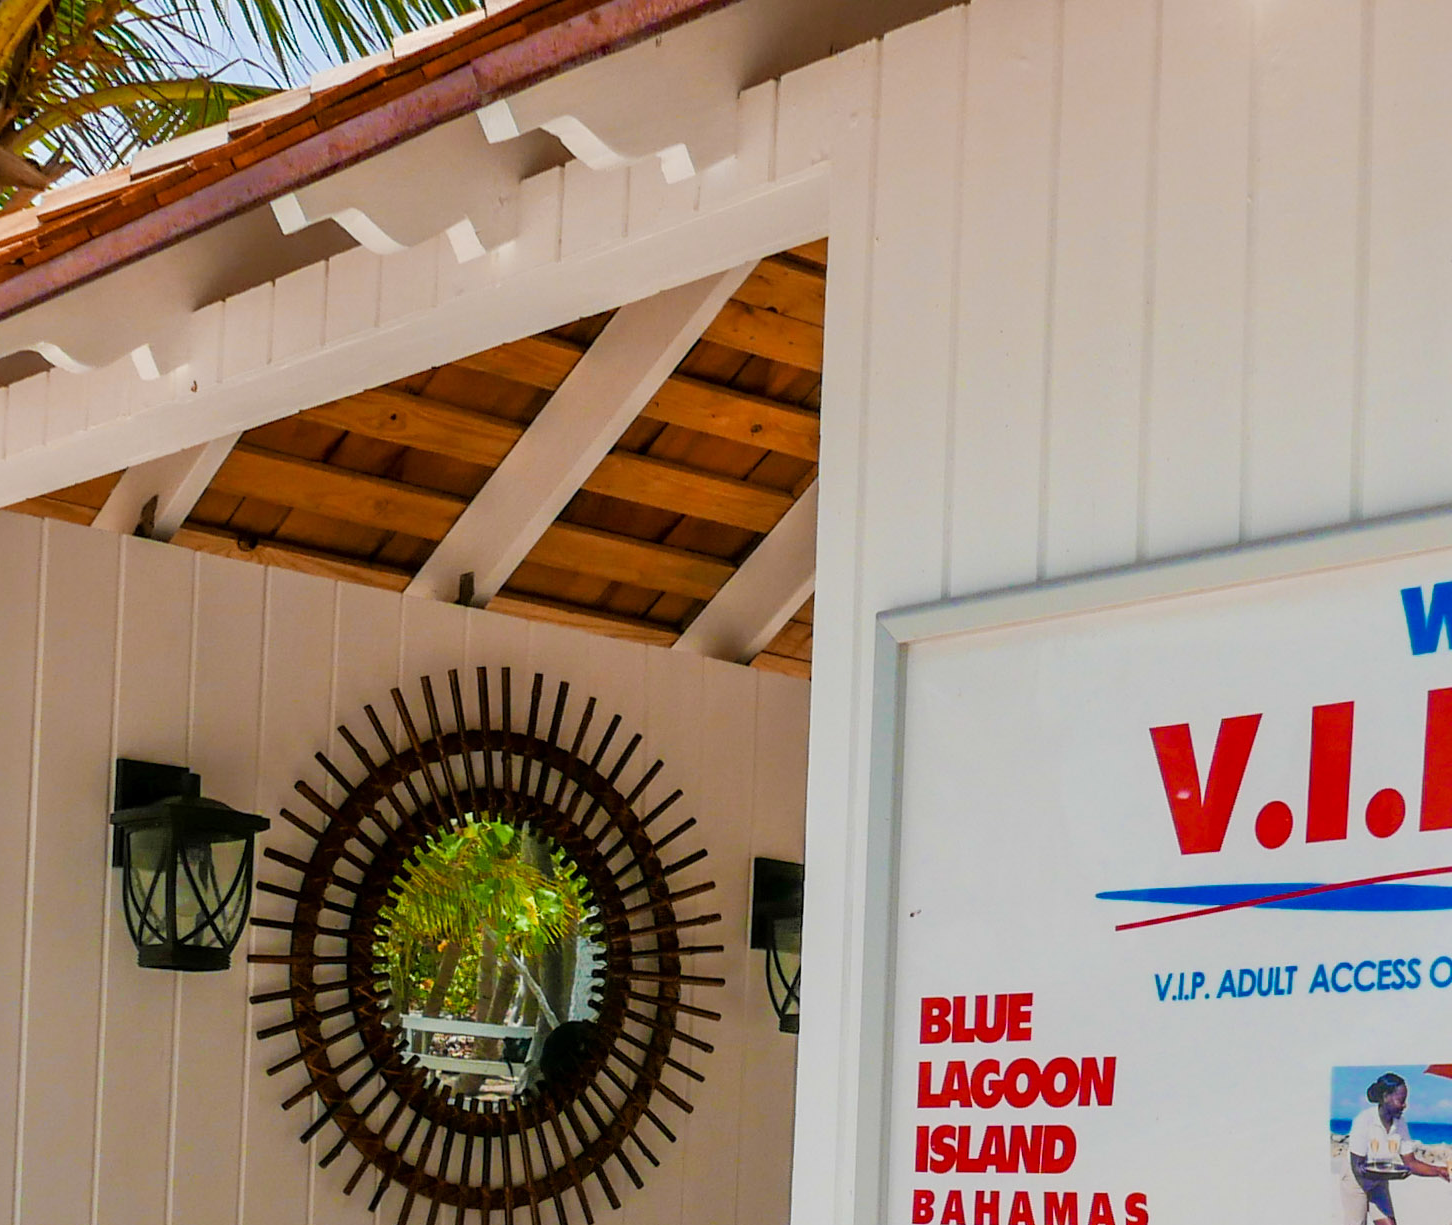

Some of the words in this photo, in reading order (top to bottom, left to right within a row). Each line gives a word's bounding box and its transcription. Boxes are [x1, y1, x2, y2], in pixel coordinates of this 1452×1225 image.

[1154, 971, 1210, 1002] V.I.P.
[1215, 965, 1299, 999] ADULT
[1308, 957, 1422, 994] ACCESS
[921, 993, 1033, 1044] BLUE
[918, 1056, 1116, 1109] LAGOON
[915, 1125, 1077, 1174] ISLAND
